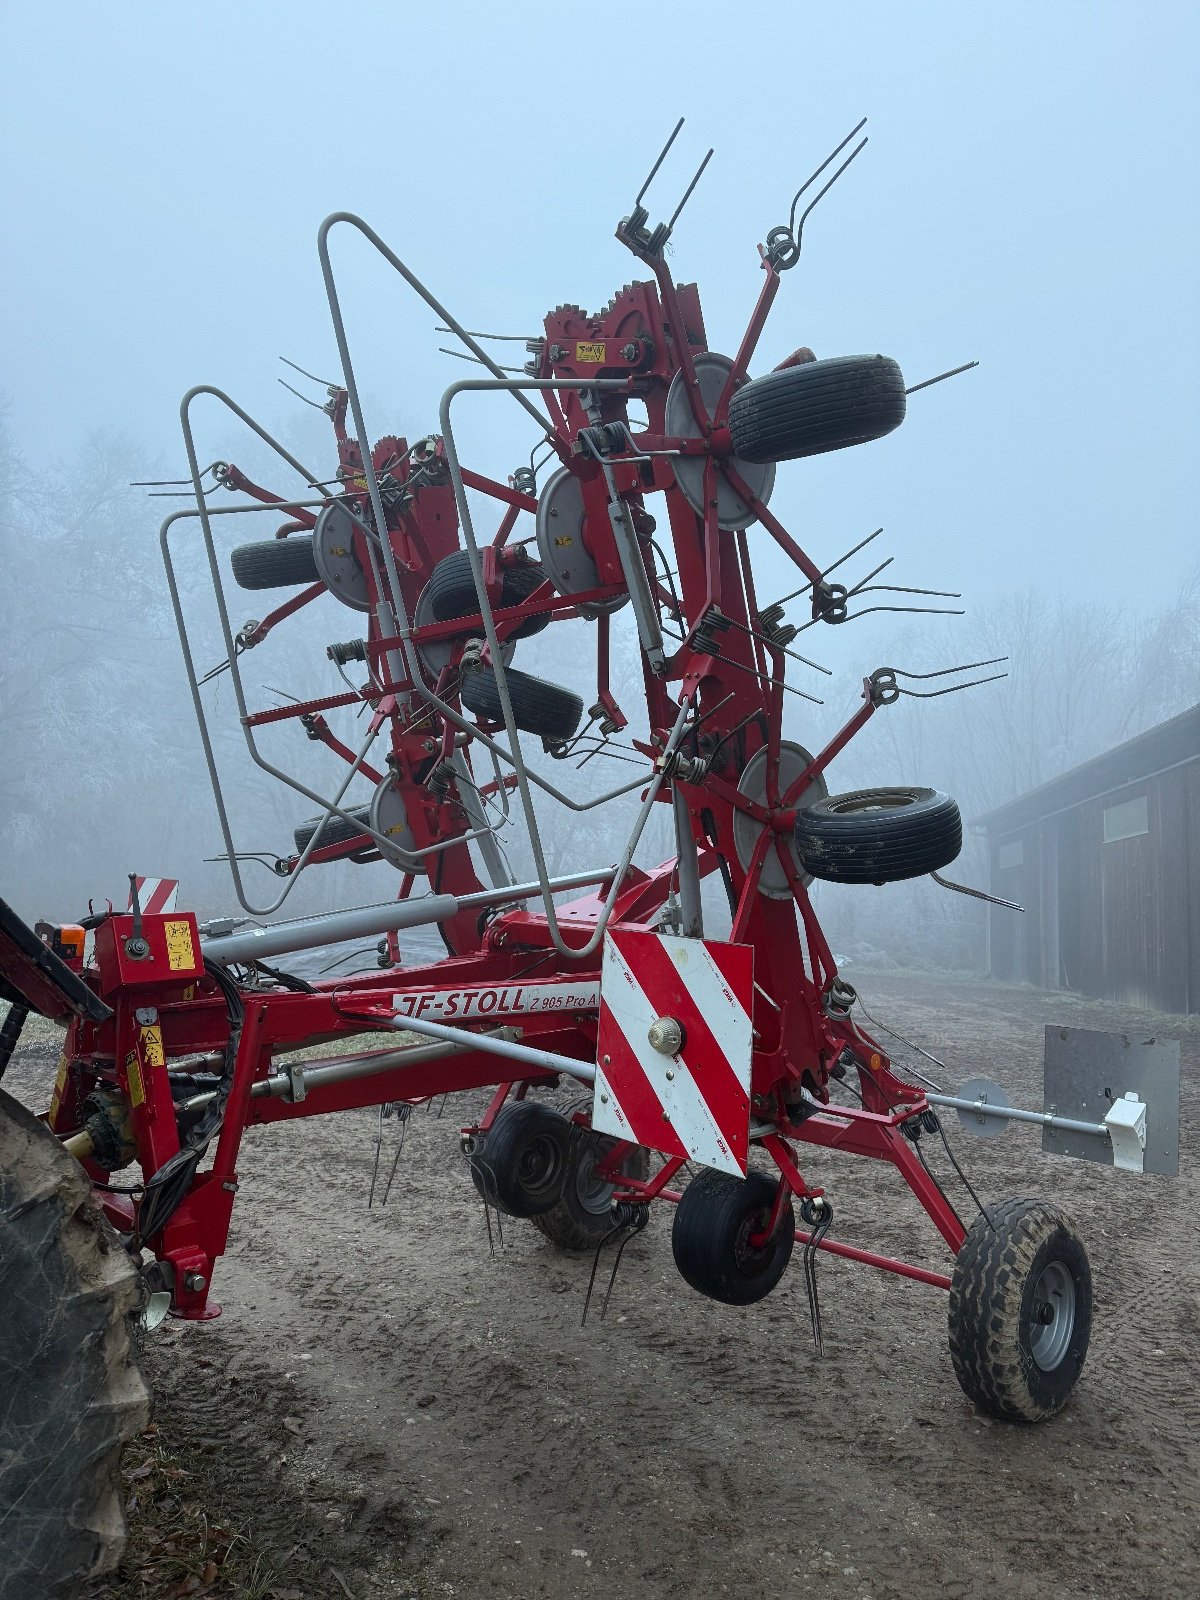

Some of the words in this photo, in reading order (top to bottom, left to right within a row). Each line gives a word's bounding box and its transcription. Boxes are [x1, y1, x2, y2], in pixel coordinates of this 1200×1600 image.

[402, 988, 525, 1019] JF-STOLL
[529, 997, 541, 1010] Z
[541, 996, 564, 1010] 905
[564, 995, 586, 1008] Pro
